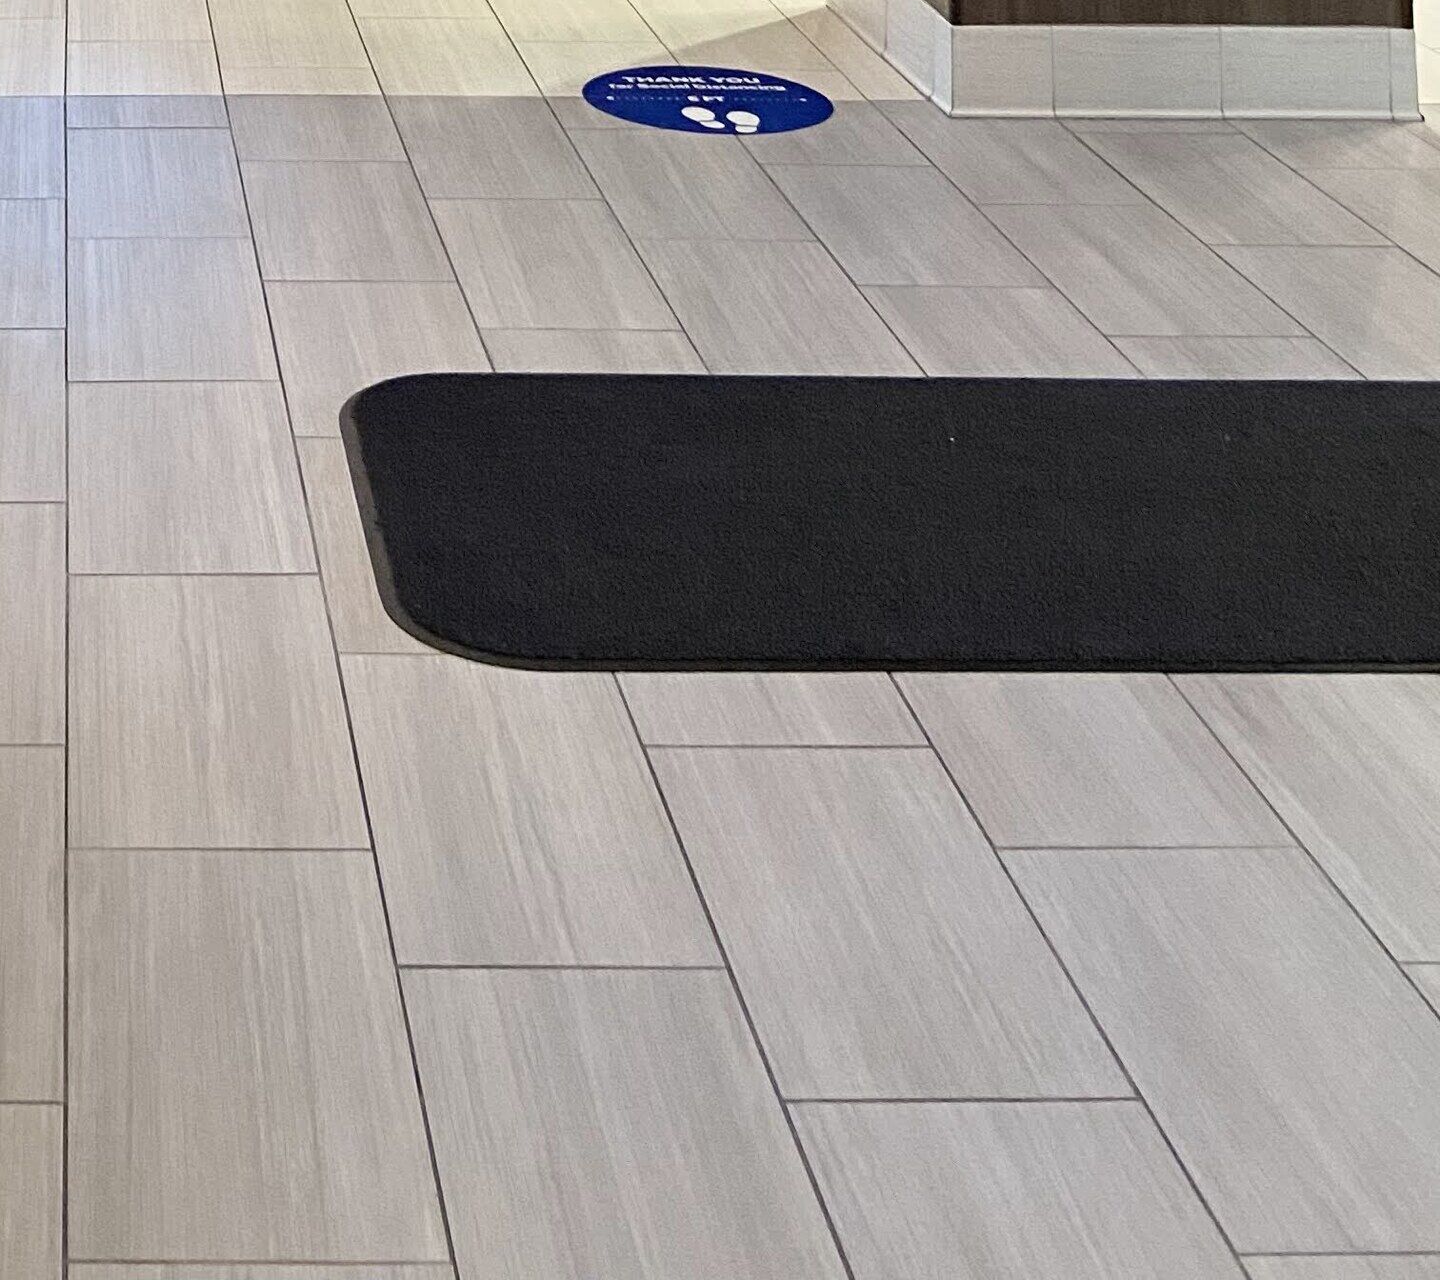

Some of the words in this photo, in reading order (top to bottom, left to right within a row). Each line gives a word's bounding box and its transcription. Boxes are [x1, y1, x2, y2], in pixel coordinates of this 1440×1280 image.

[622, 76, 707, 84] THANK
[709, 76, 760, 84] YOU
[692, 83, 787, 91] Distancing
